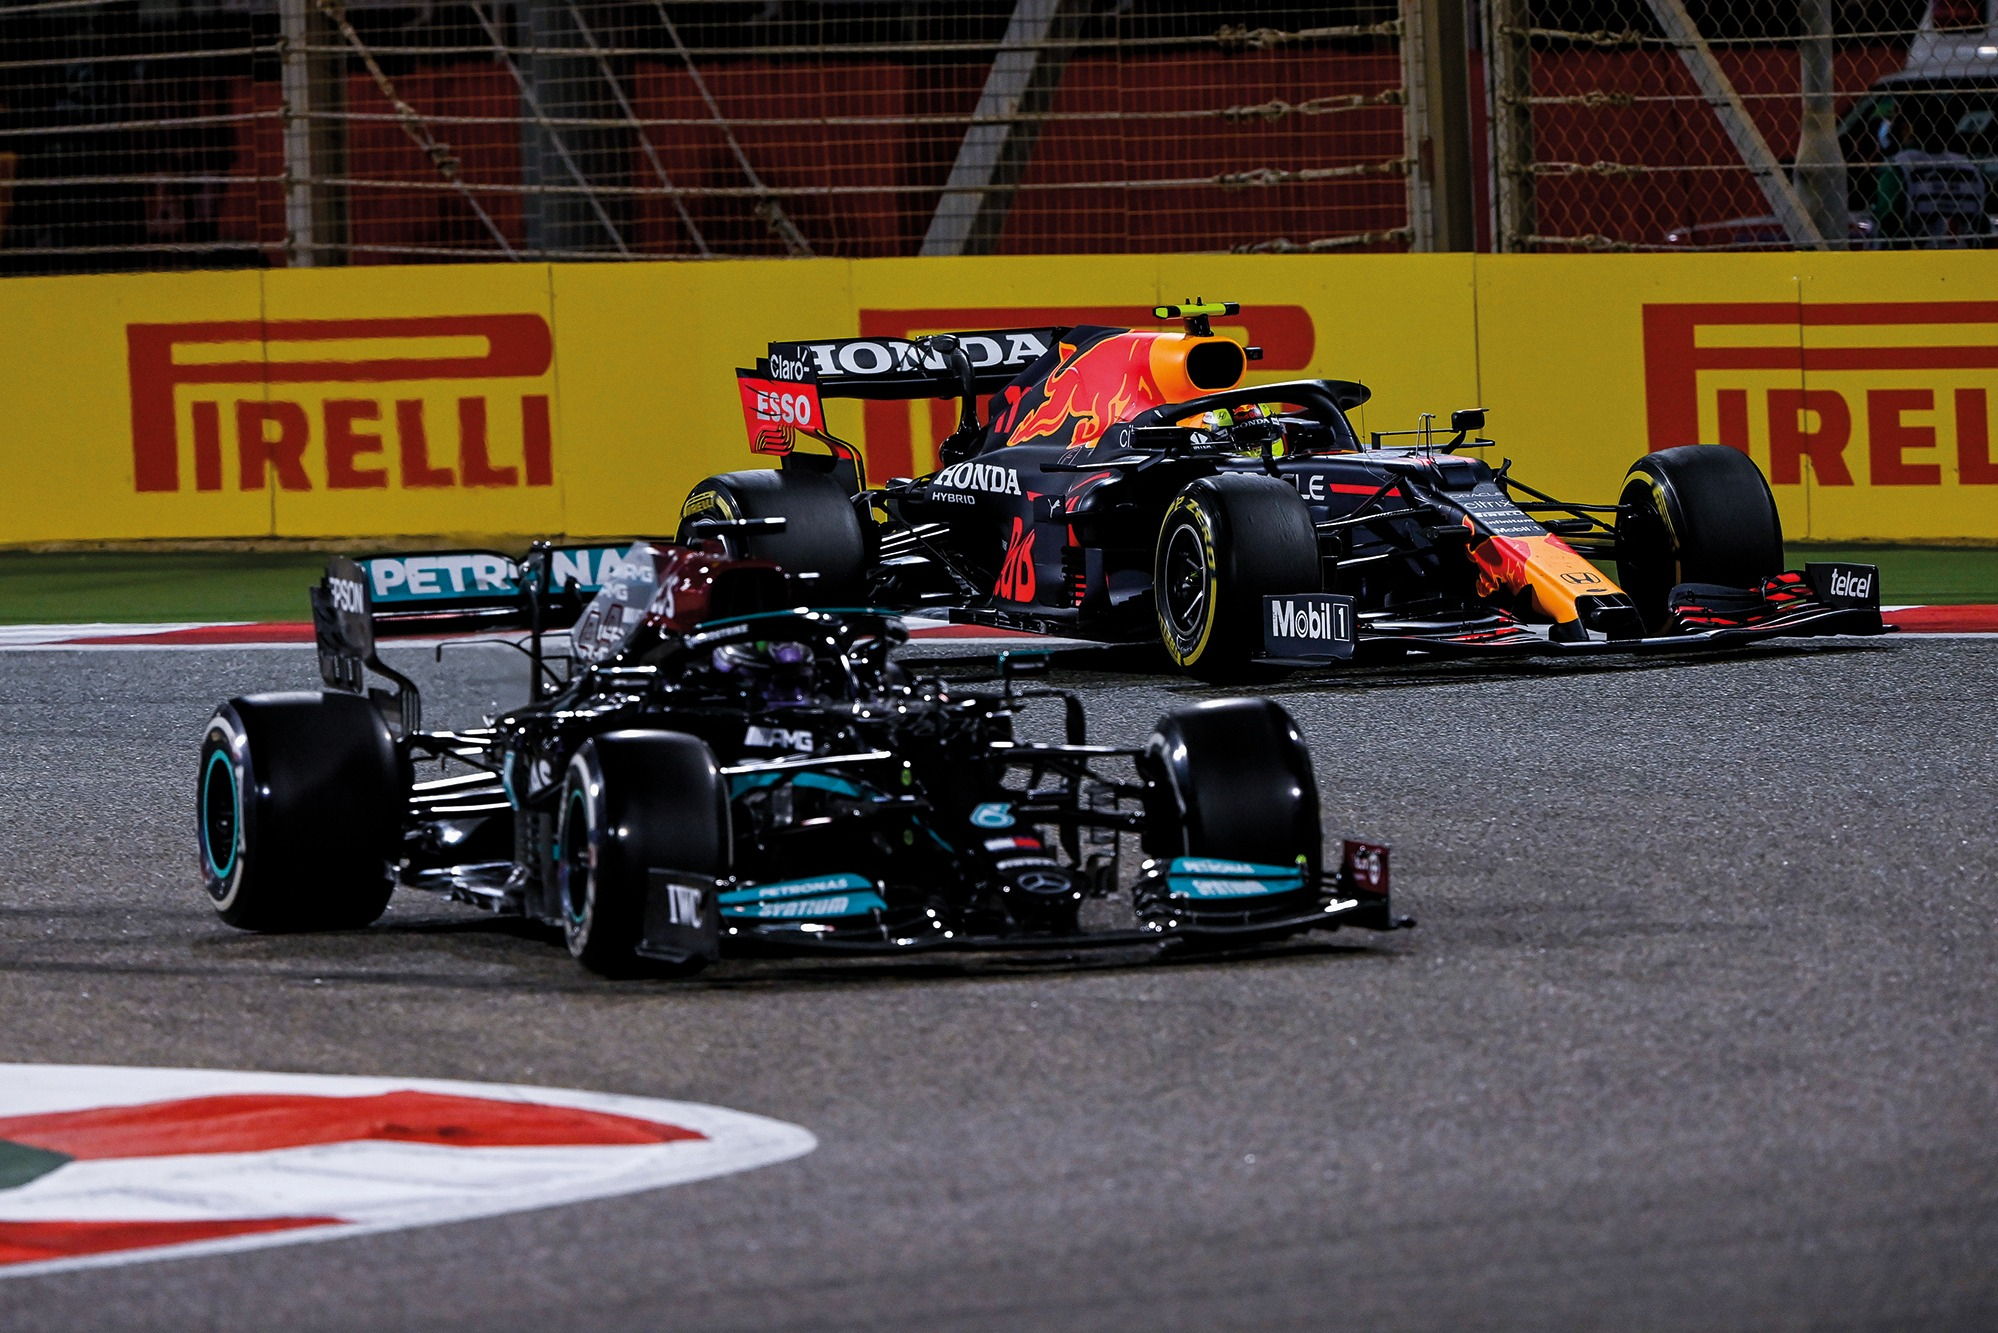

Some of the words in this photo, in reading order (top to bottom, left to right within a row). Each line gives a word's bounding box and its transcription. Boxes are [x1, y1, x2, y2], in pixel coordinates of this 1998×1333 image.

[770, 353, 803, 381] Claro
[809, 332, 1049, 375] HONDA
[126, 312, 553, 493] PIRELLI
[756, 390, 811, 425] ESSO
[933, 462, 1022, 496] HONDA
[932, 491, 976, 505] HYBRID
[371, 549, 632, 596] PETRNA
[1830, 568, 1872, 598] telcel
[1271, 600, 1332, 640] Mobil
[768, 729, 814, 751] AMG
[758, 878, 849, 898] PETRONAS
